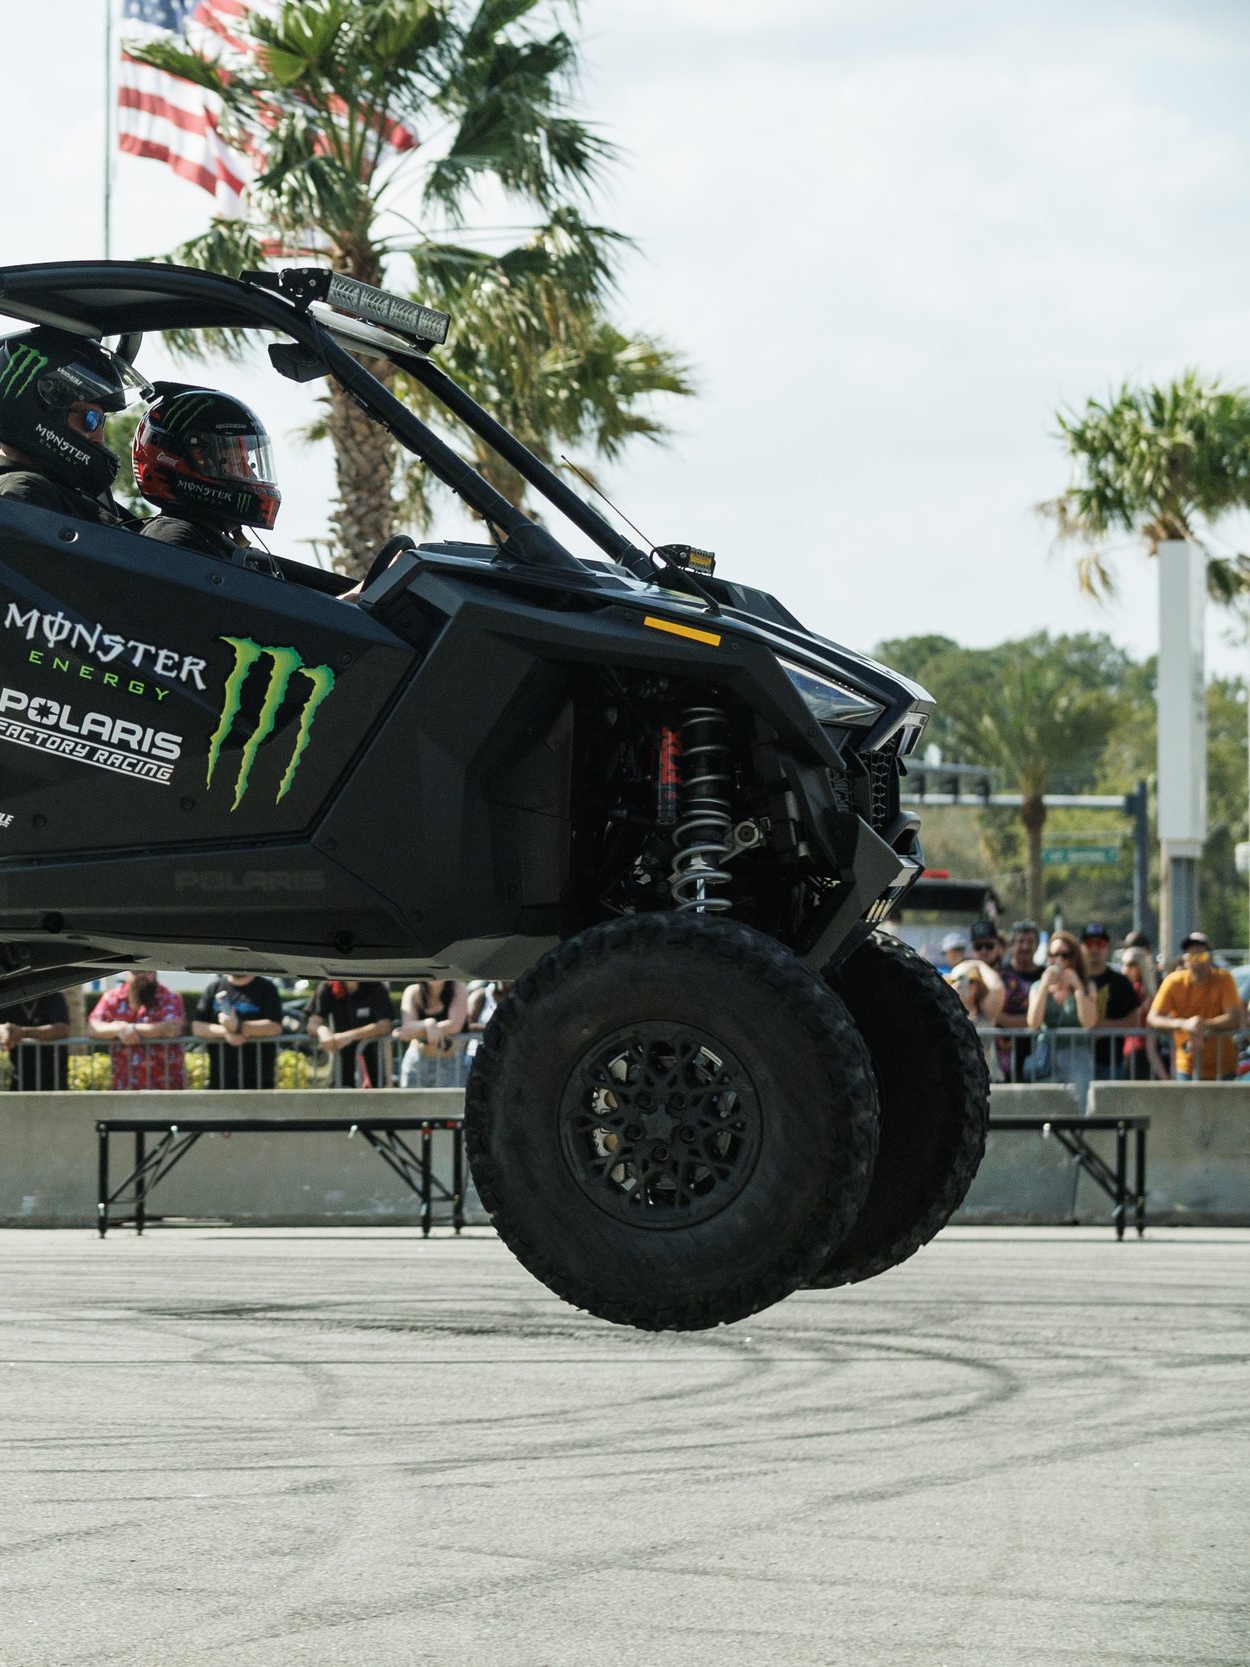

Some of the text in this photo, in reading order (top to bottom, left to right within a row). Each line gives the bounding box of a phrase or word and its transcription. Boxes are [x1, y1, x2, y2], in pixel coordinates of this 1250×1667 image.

[35, 423, 91, 465] MONSTER
[177, 480, 232, 502] MONSTER
[4, 602, 207, 690] MONSTER
[28, 650, 170, 700] ENERGY
[92, 750, 174, 781] RACING
